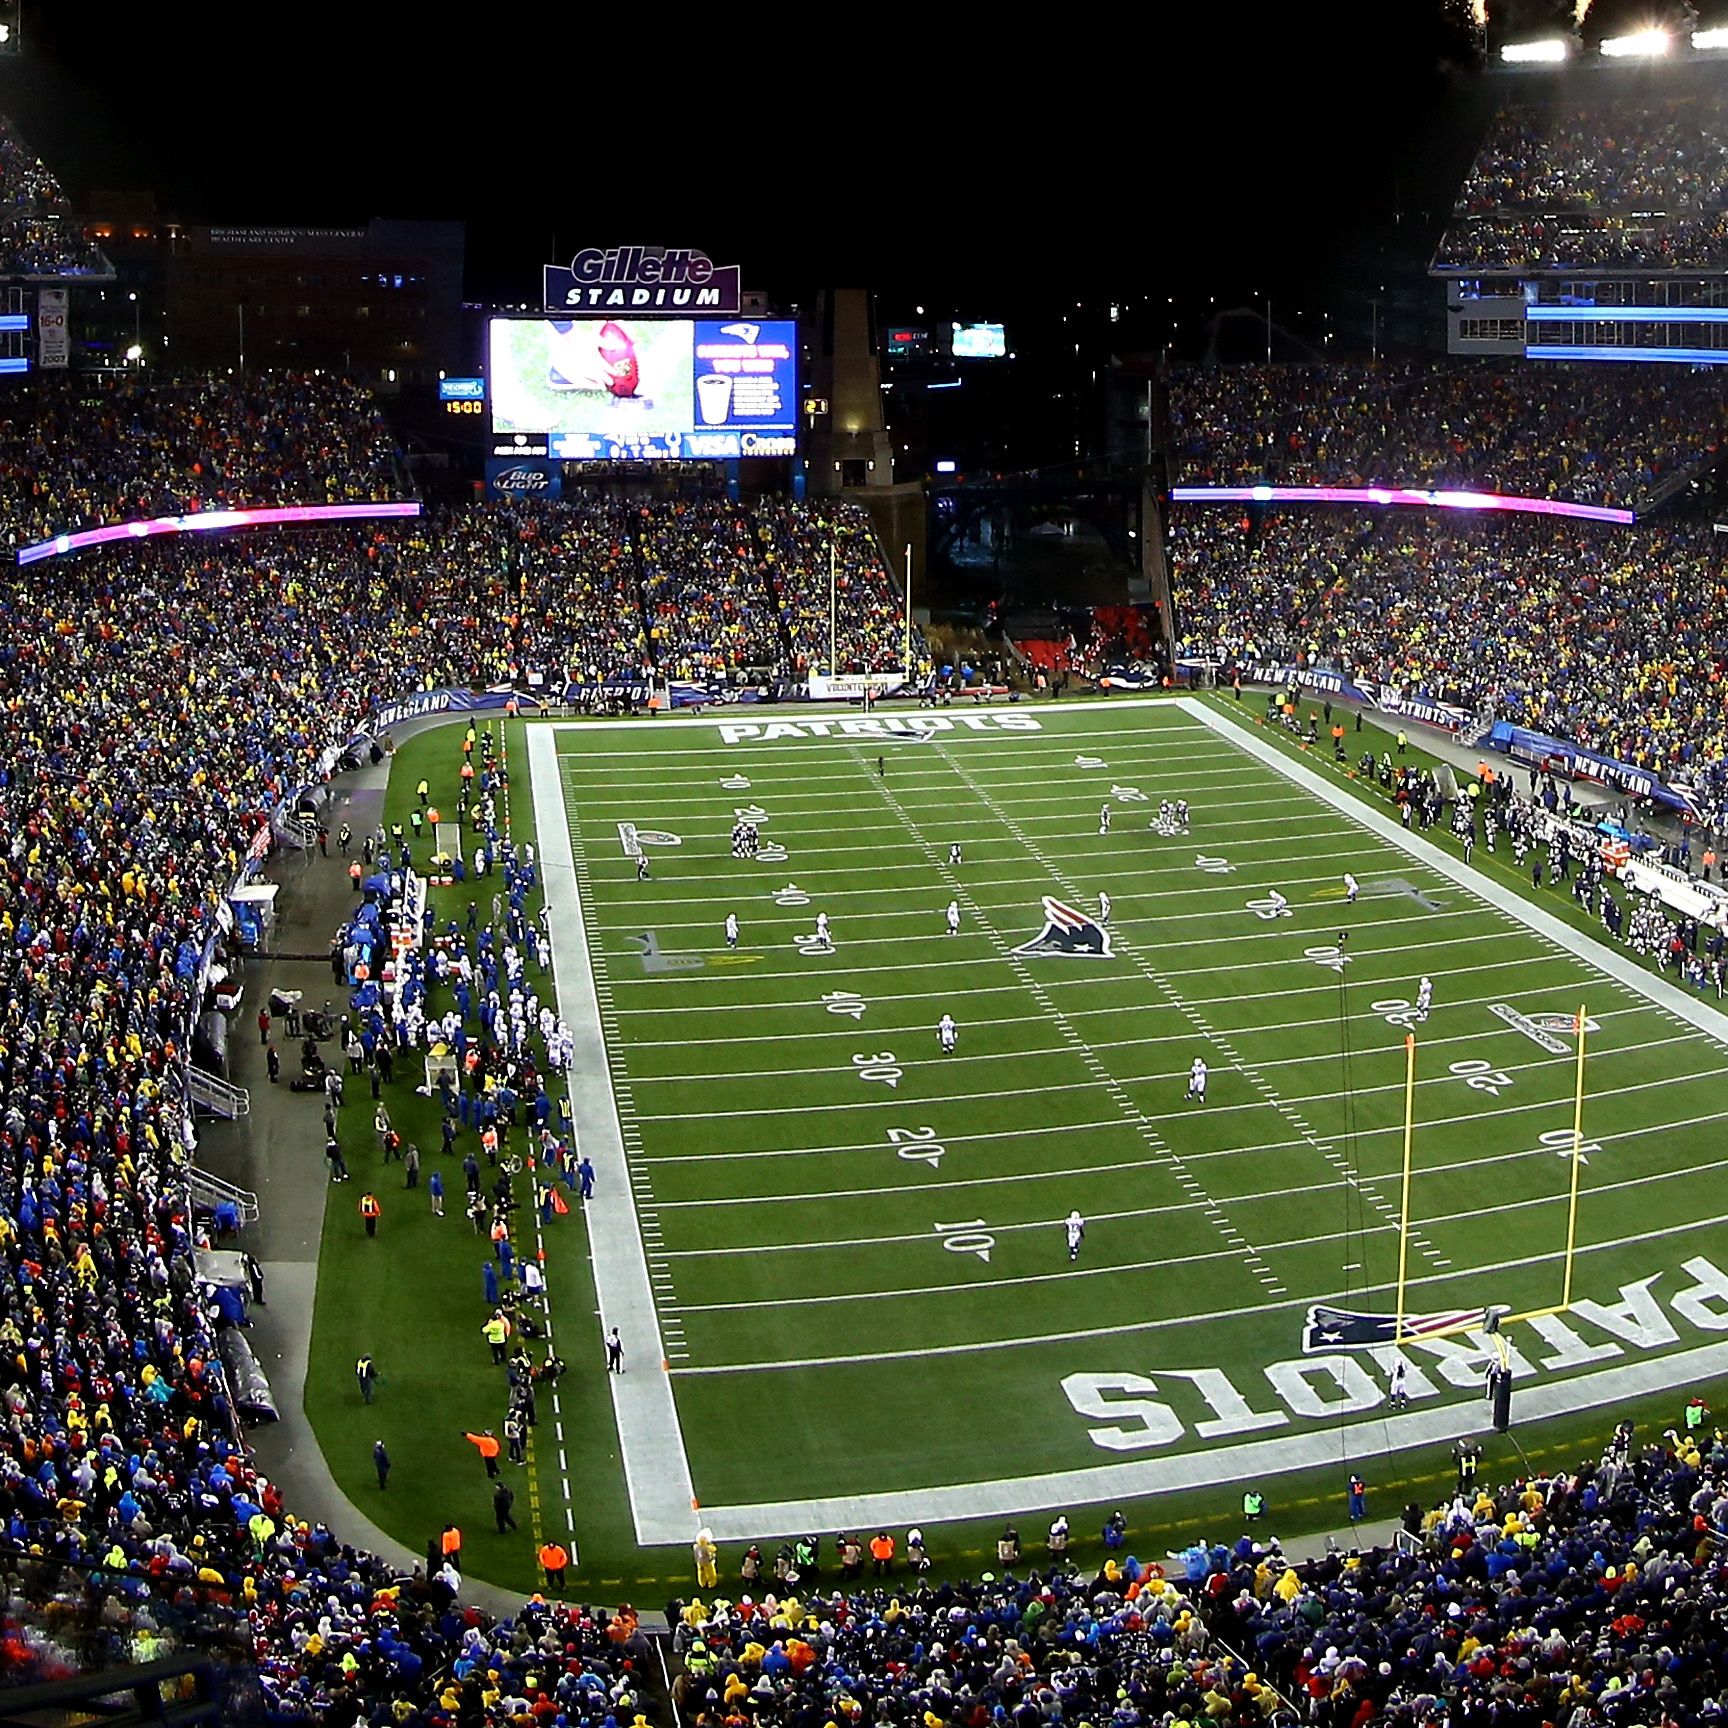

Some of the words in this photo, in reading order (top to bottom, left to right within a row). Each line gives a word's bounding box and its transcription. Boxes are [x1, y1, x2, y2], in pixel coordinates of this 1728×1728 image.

[571, 246, 715, 284] Gillette
[565, 288, 720, 305] STADIUM
[40, 315, 64, 327] 16-0
[446, 401, 482, 414] 15:00
[683, 435, 740, 456] VISA
[502, 480, 549, 489] LIGHT
[510, 471, 544, 481] BUD
[1253, 667, 1286, 682] NEW
[1287, 670, 1342, 692] ENGLAND
[1399, 701, 1446, 724] ATRIOTS
[717, 714, 1044, 744] PATRIOTS
[1575, 755, 1600, 777] NEW
[821, 991, 867, 1014] 40
[852, 1051, 903, 1082] 30
[1448, 1060, 1514, 1089] 20
[887, 1126, 945, 1160] 20
[1538, 1128, 1603, 1158] 10
[934, 1218, 996, 1252] 10
